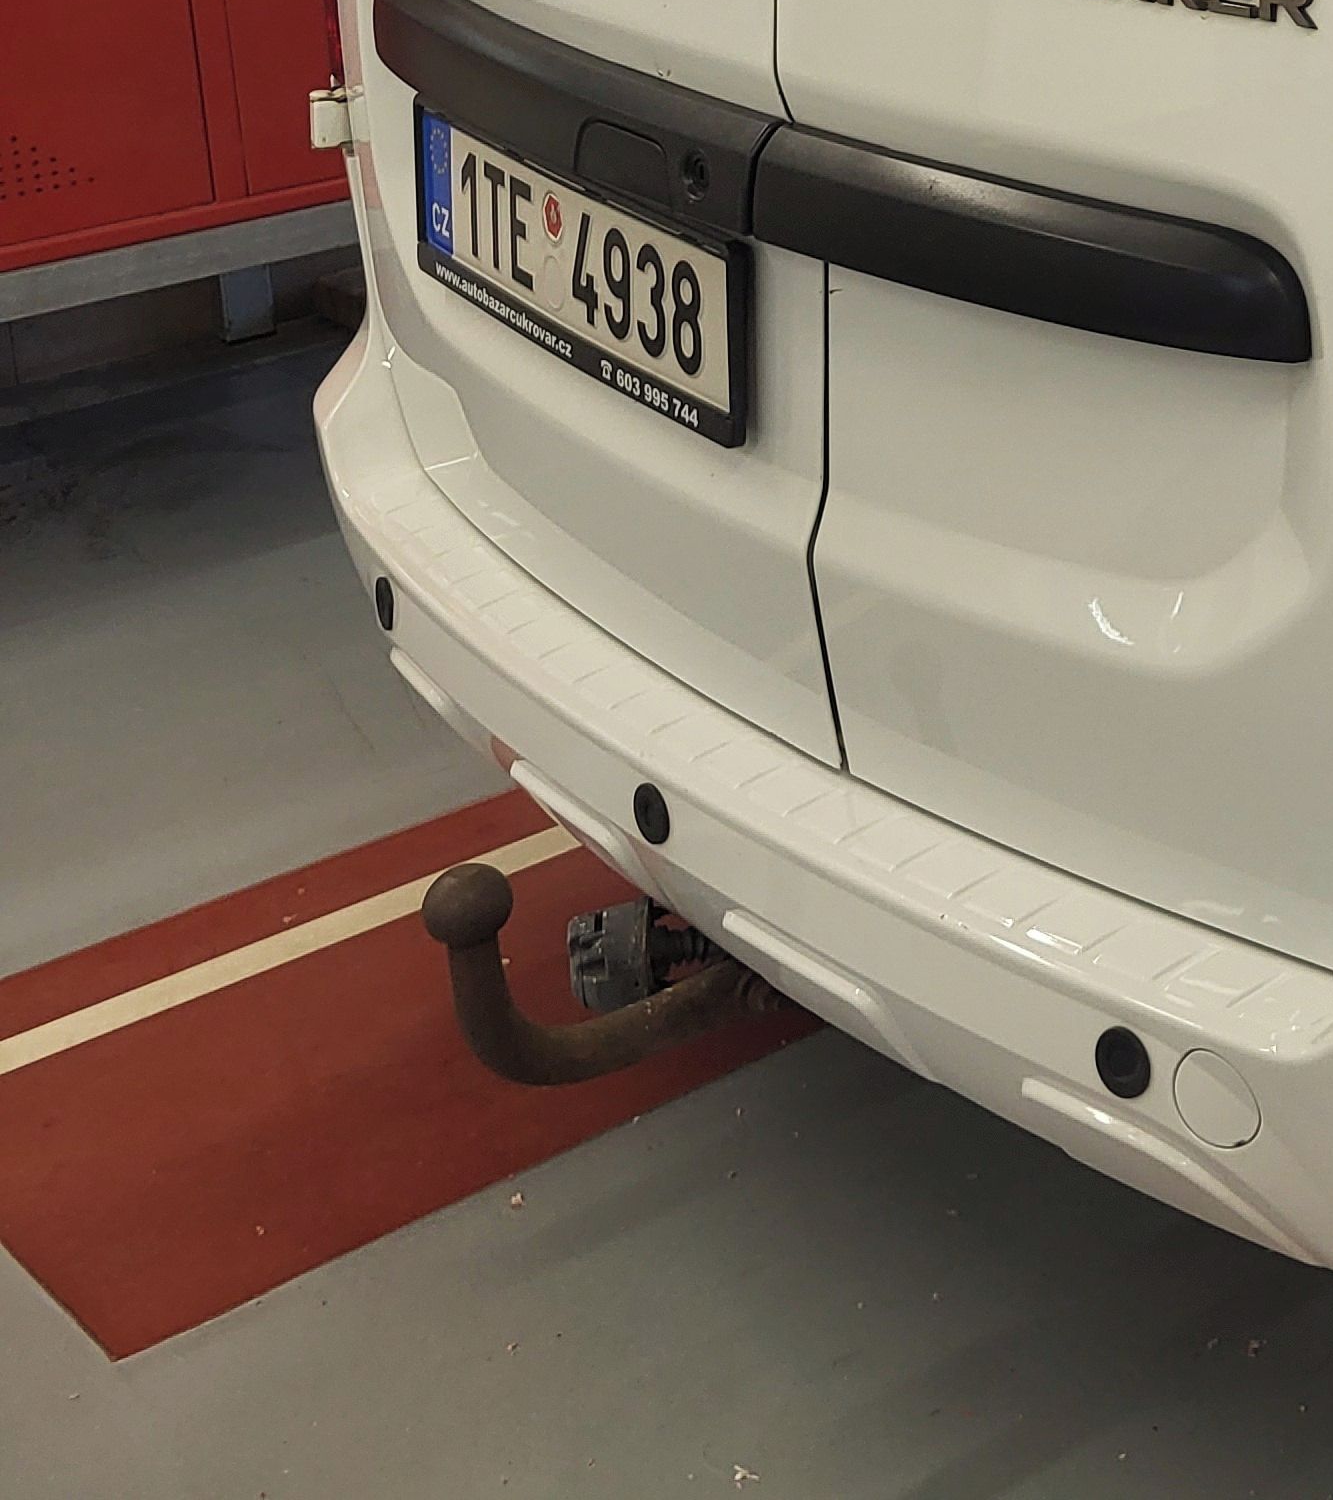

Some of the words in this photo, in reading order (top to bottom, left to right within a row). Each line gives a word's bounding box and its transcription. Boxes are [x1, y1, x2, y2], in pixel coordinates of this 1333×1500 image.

[432, 202, 451, 239] CZ
[461, 151, 534, 292] 1TE
[571, 211, 702, 376] 4938
[435, 261, 573, 359] www.autobazarcukrovar.cz
[616, 368, 641, 398] 603
[644, 381, 670, 412] 995
[672, 398, 699, 428] 744
